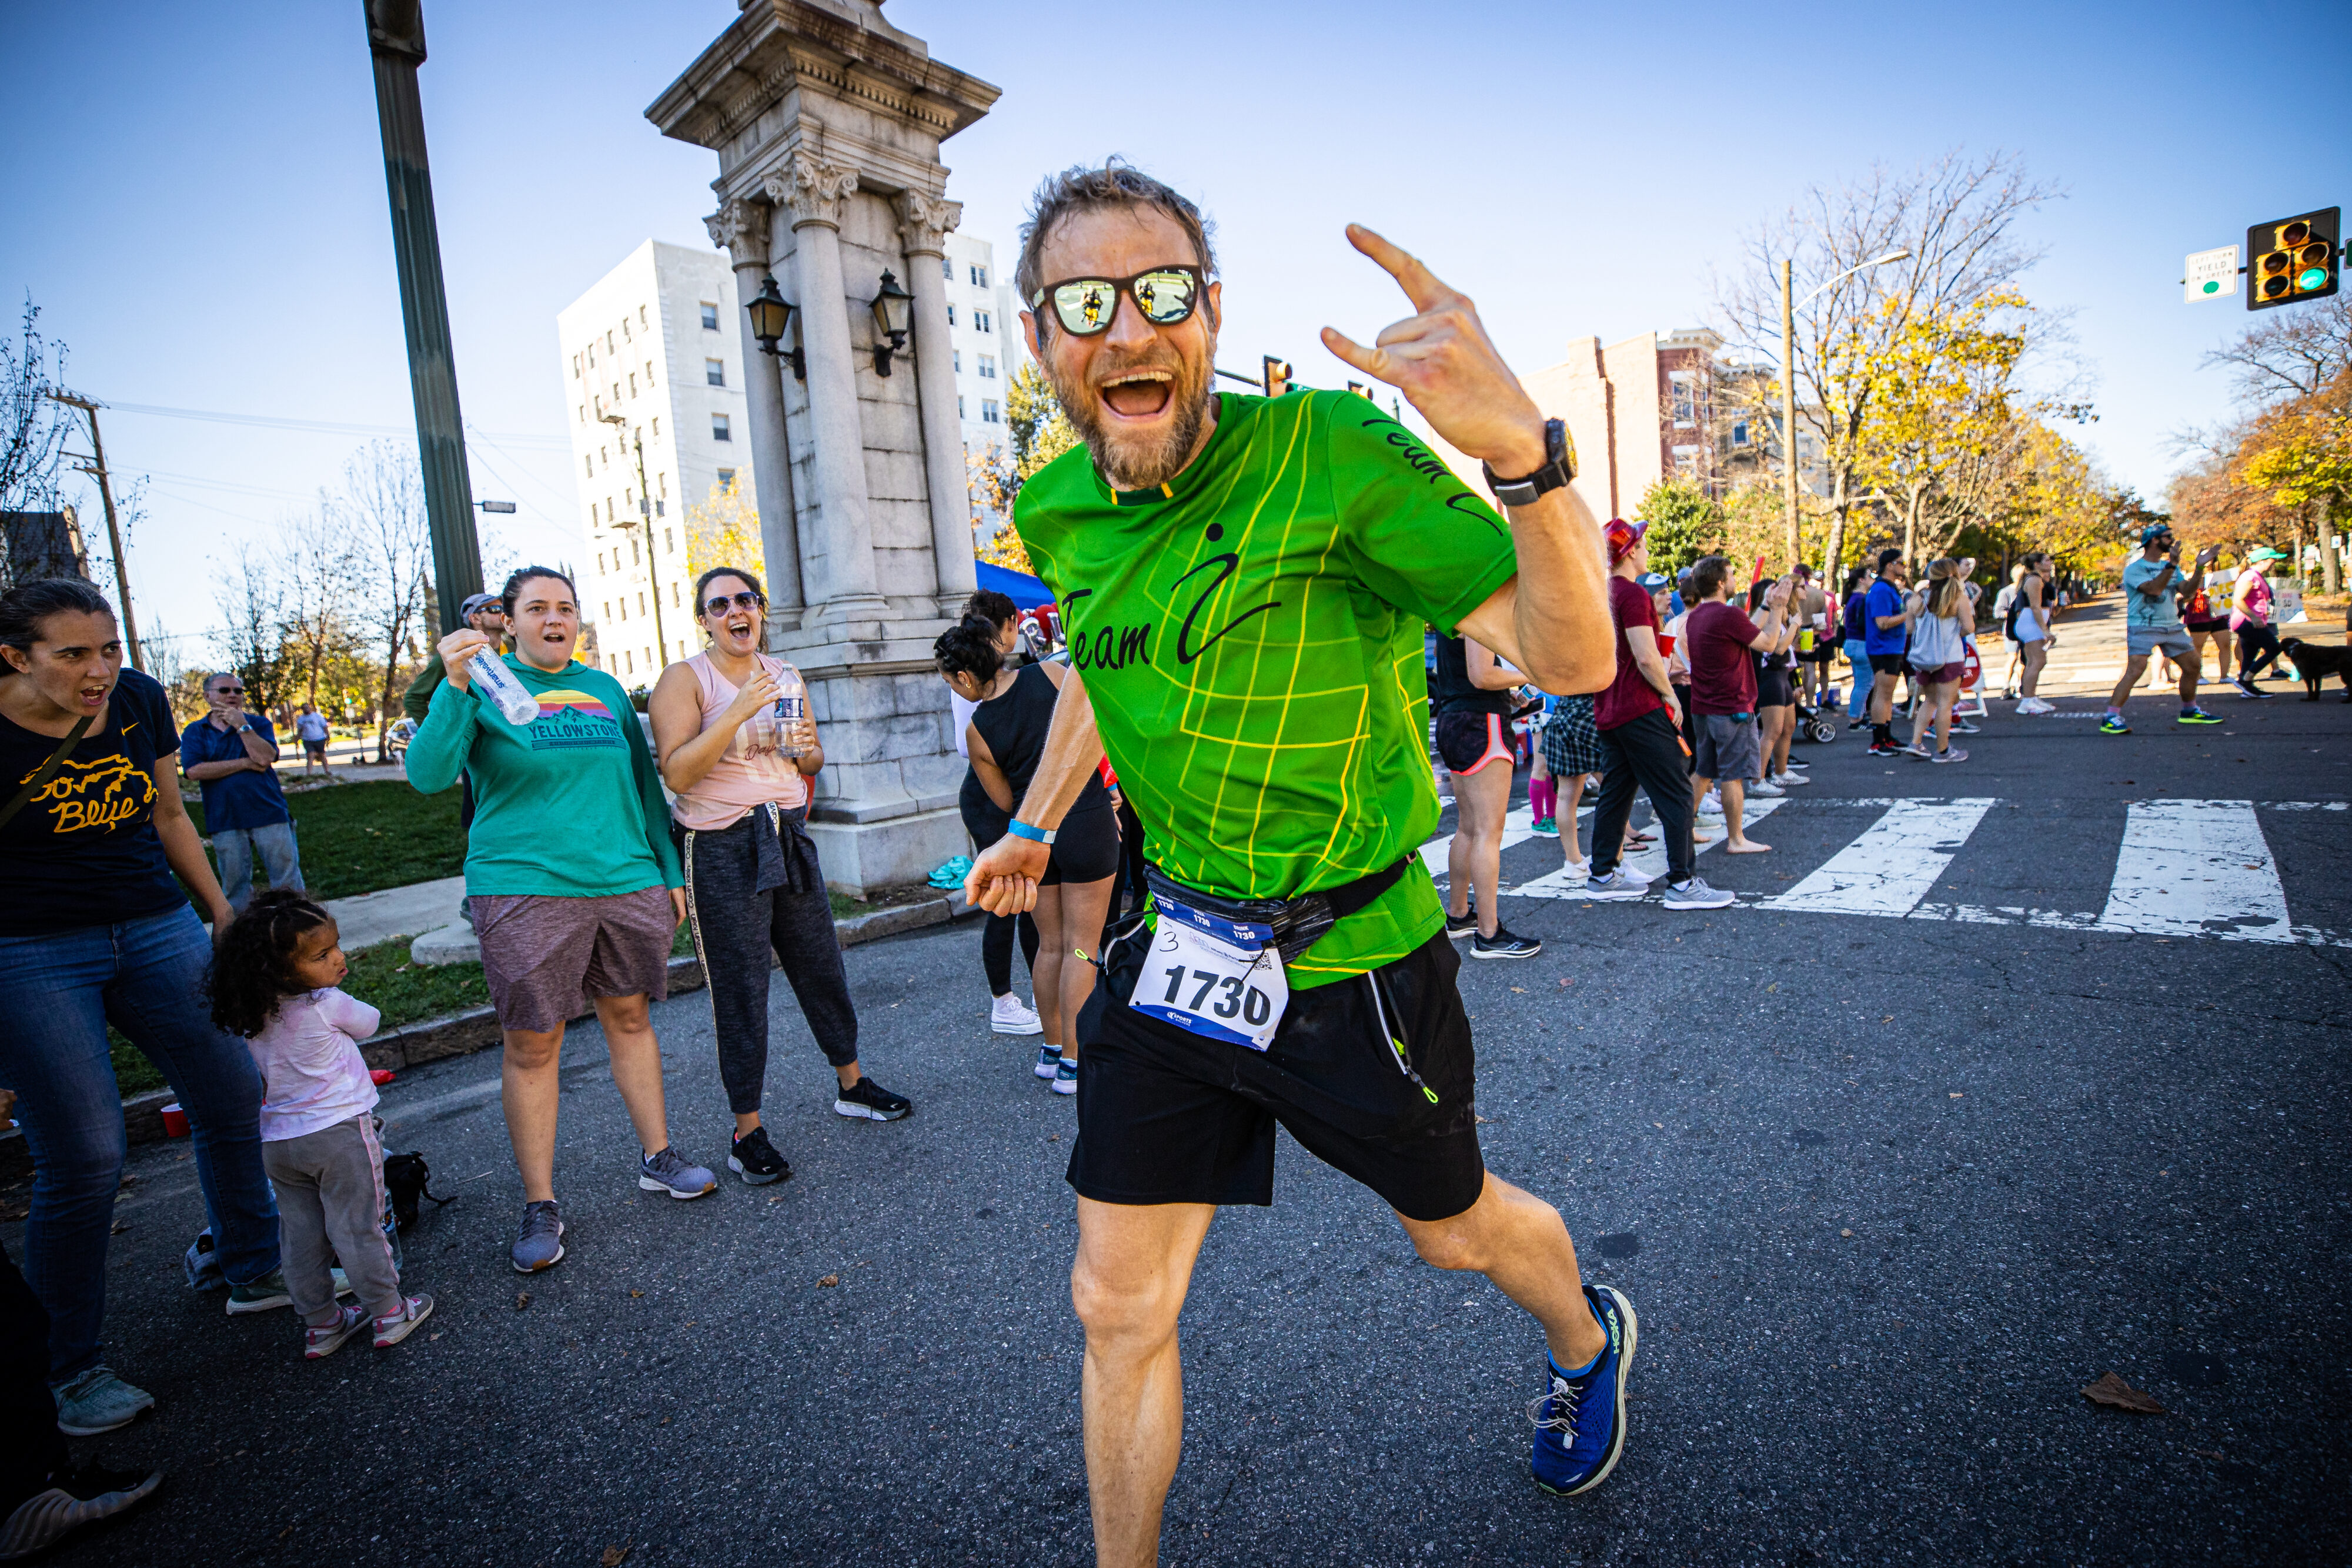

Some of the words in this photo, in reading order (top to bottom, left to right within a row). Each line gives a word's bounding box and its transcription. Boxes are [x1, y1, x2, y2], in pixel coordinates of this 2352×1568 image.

[2199, 261, 2226, 272] YIELD
[2206, 269, 2232, 279] GREEN
[1062, 588, 1152, 671] Team
[476, 656, 505, 688] smartwater
[528, 724, 623, 738] YELLOWSTONE
[48, 797, 139, 833] Blue
[769, 802, 778, 824] Calvin
[1157, 898, 1175, 911] 1730
[690, 913, 699, 931] Klein
[1194, 914, 1211, 927] 1730
[694, 931, 703, 955] Calvin
[1159, 931, 1179, 952] 3
[1234, 930, 1255, 940] 1730
[1164, 965, 1271, 1026] 1730
[1174, 1014, 1192, 1024] SPORTS
[1607, 1308, 1620, 1355] HOKA
